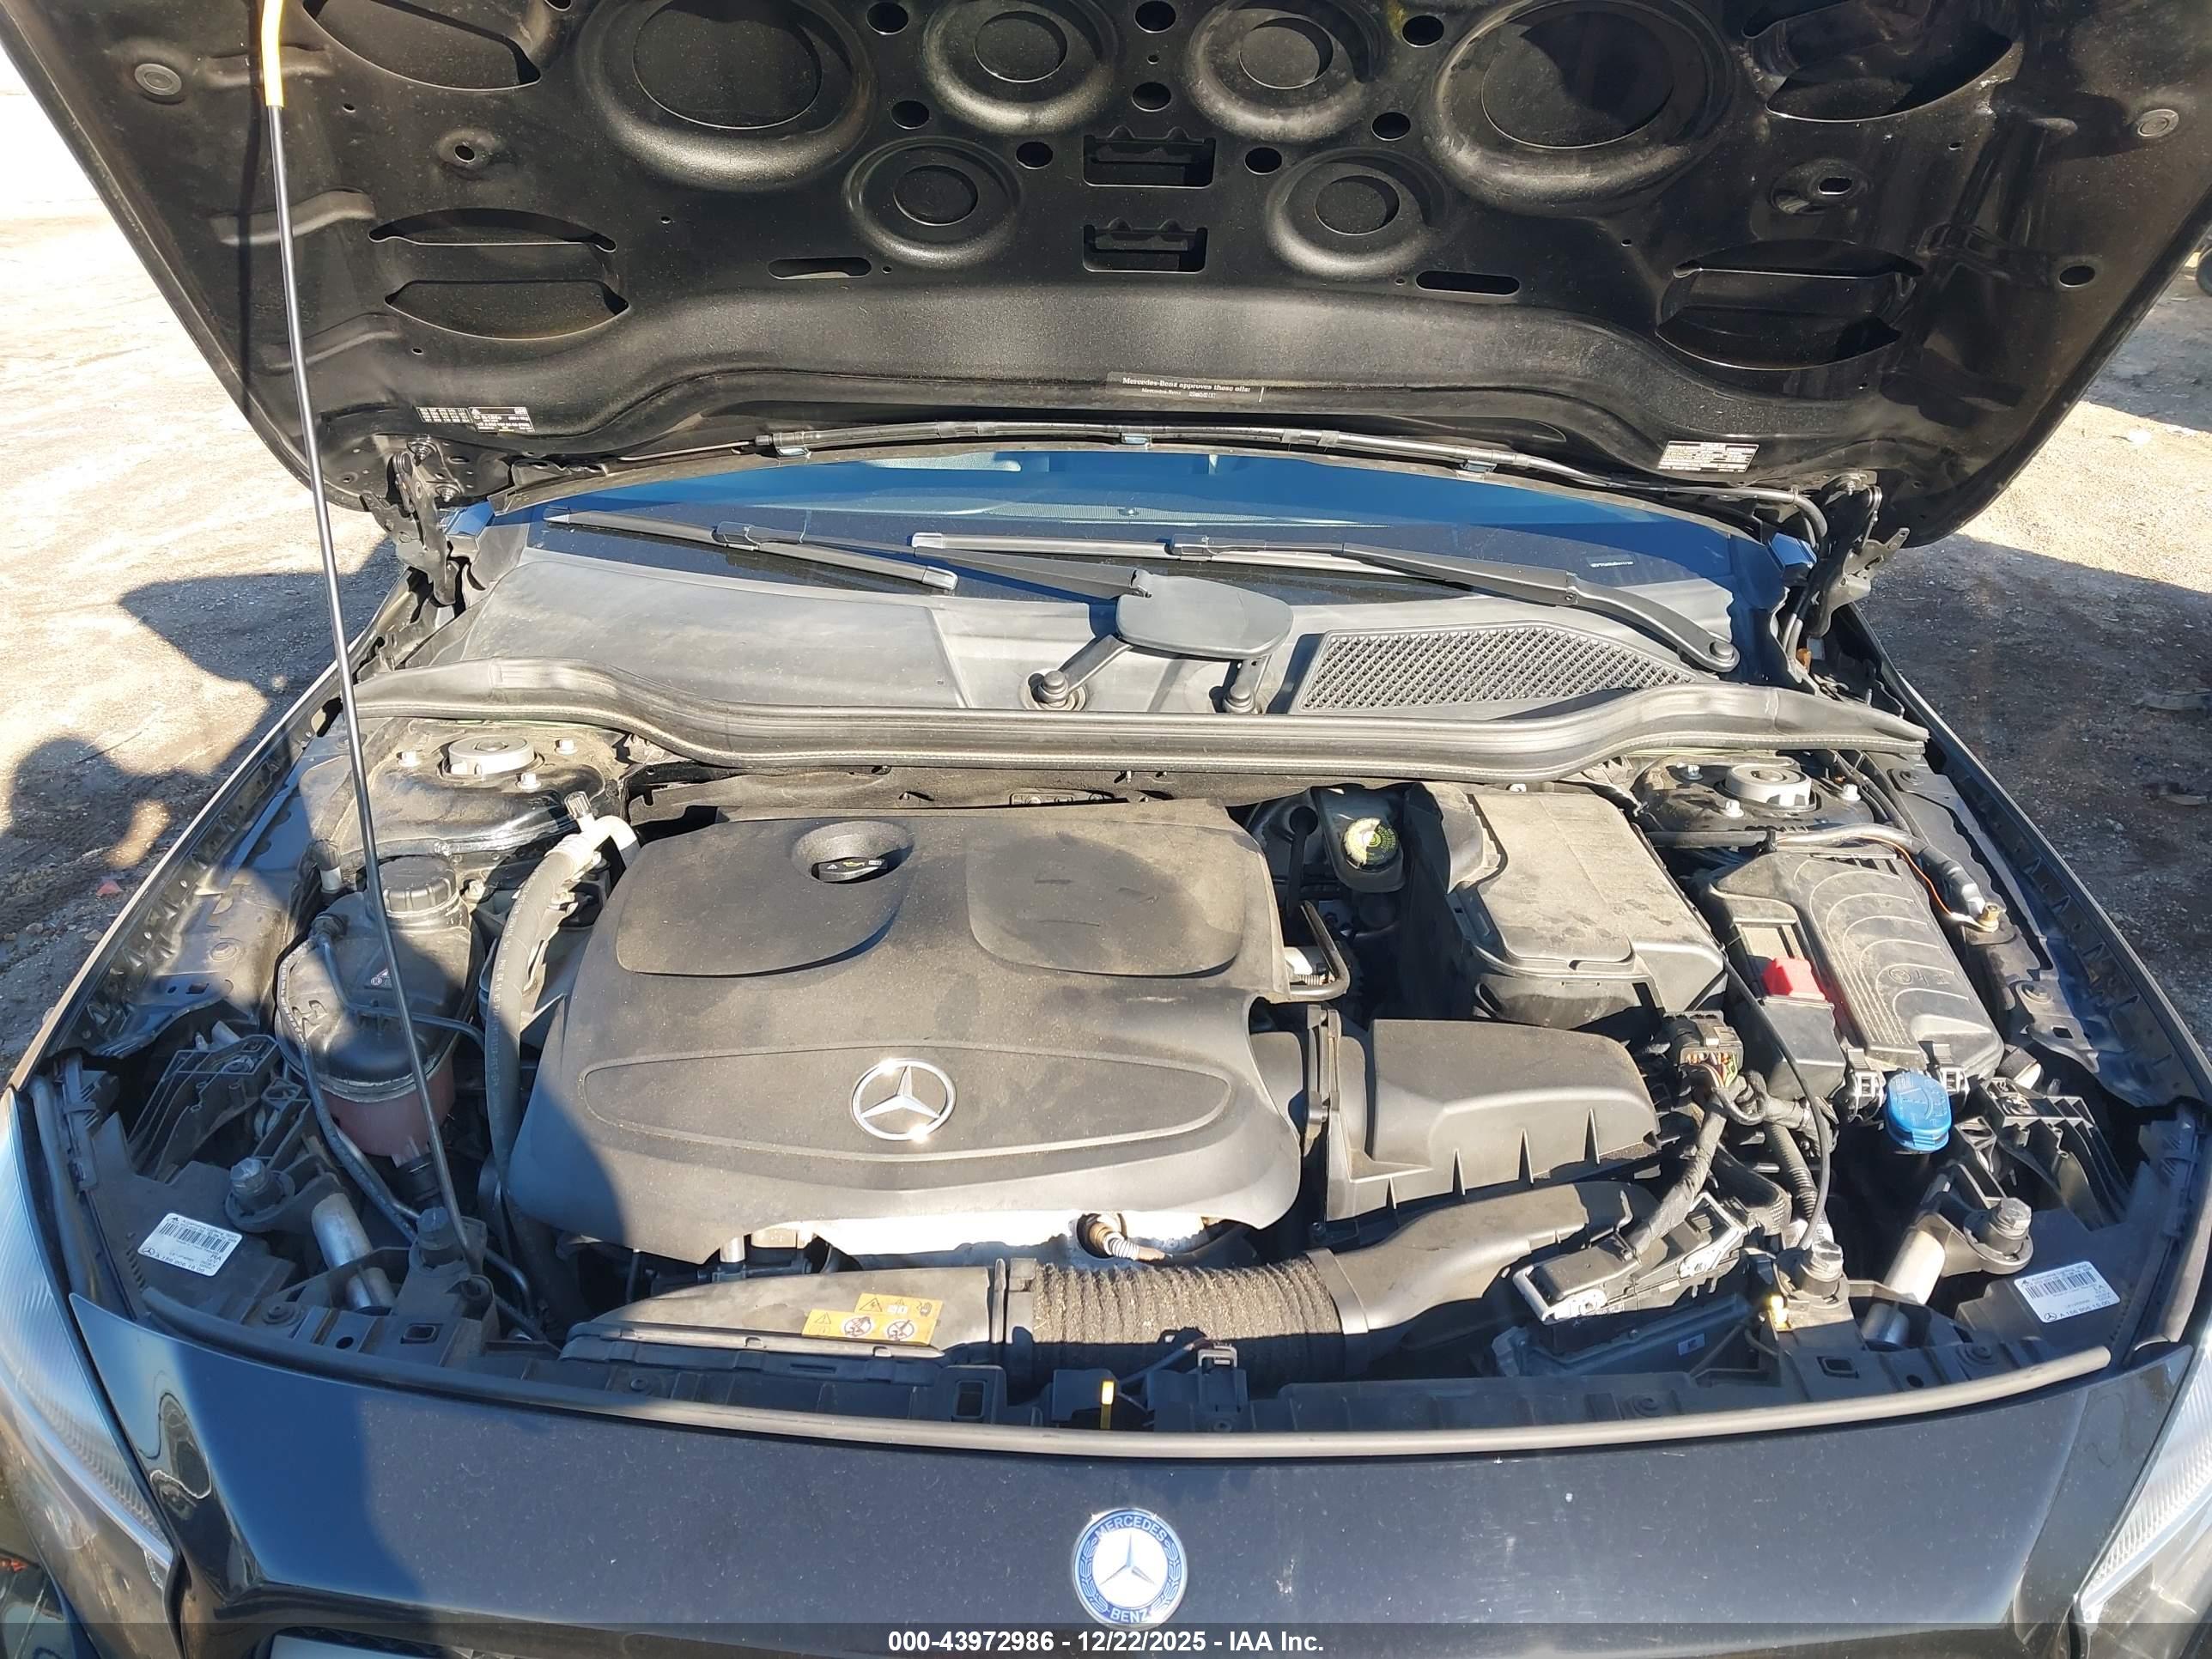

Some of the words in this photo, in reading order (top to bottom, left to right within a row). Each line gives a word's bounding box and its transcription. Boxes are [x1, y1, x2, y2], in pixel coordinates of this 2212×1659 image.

[1122, 377, 1178, 388] Mercedes-Benz
[1179, 382, 1212, 392] approves
[1213, 384, 1234, 392] these
[1095, 1515, 1168, 1542] MERCEDES
[1109, 1608, 1149, 1623] BENZ
